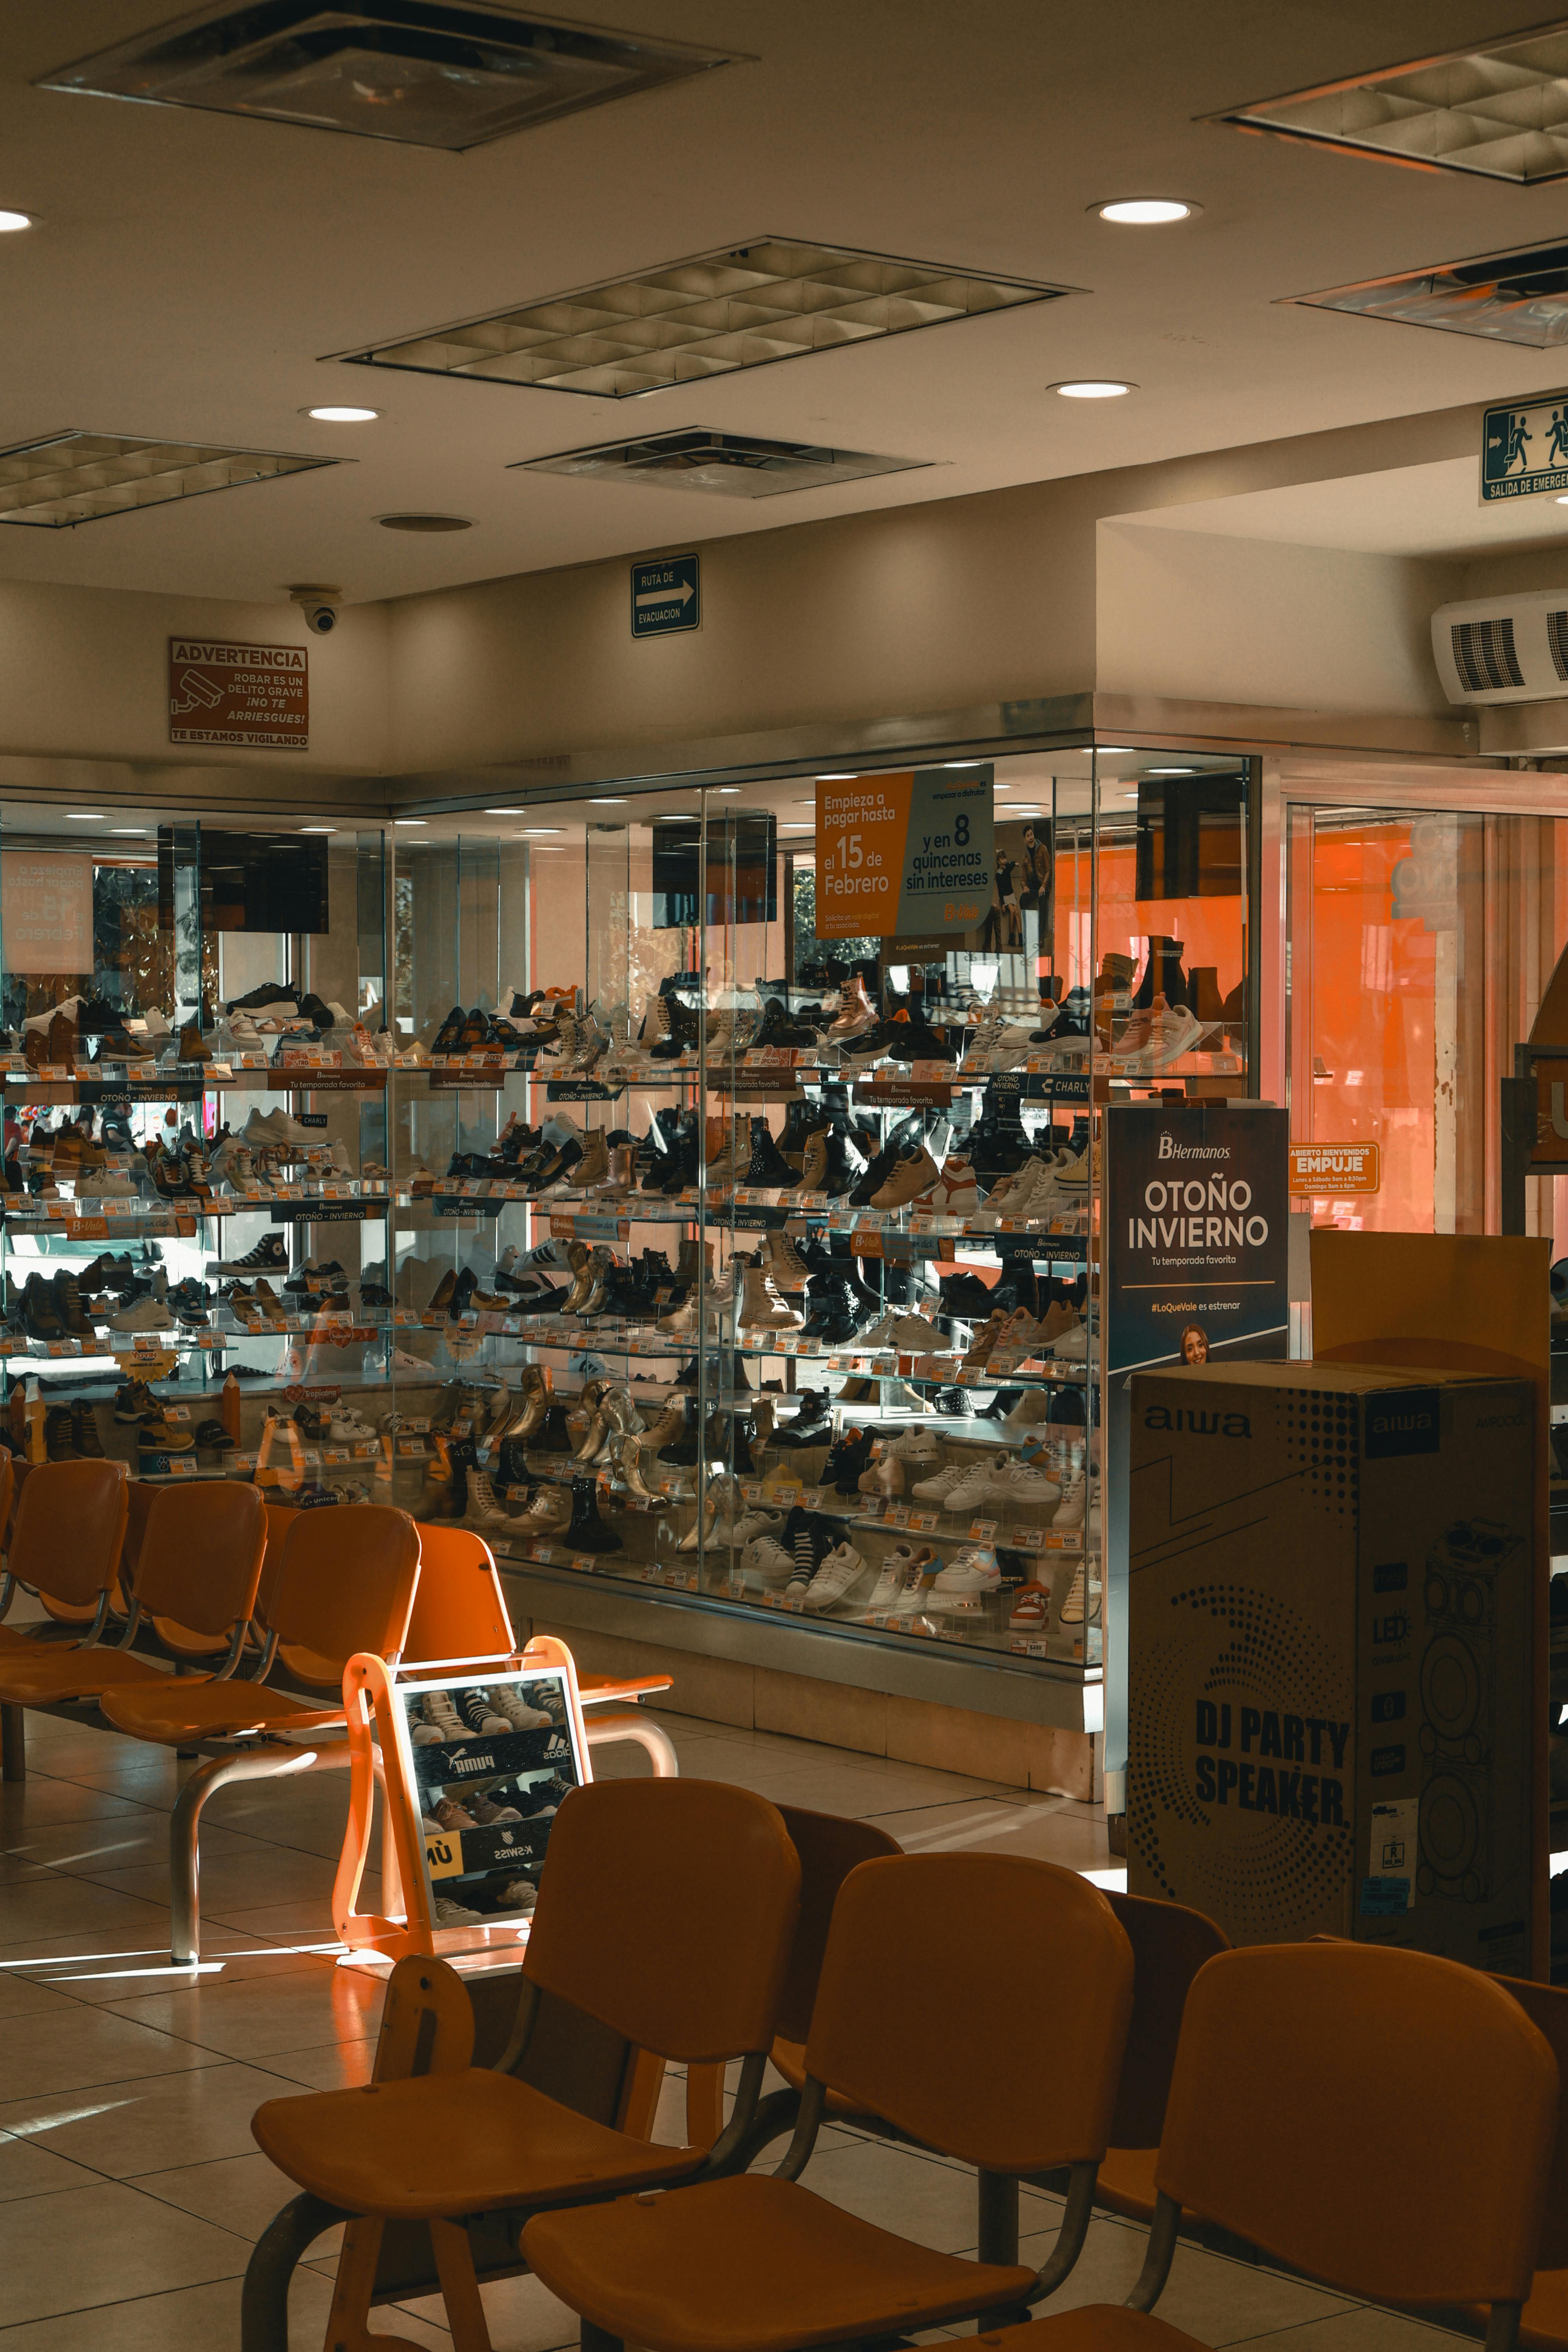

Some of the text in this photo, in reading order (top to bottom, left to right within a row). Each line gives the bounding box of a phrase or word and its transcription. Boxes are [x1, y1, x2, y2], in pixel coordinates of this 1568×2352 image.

[1490, 481, 1518, 497] SALIDA
[1521, 479, 1531, 493] DE
[642, 571, 673, 587] RUTA DE
[639, 608, 680, 624] EVACUACION
[175, 645, 303, 668] ADVERTENCIA
[234, 673, 303, 686] ROBAR ES UN
[228, 684, 303, 697] DELITO GRAVE
[246, 697, 286, 708] ¡NO TE
[227, 711, 305, 724] ARRIESGUES!
[172, 730, 307, 745] TE ESTAMOS VIGILANDO
[947, 781, 979, 790] #LoQueVale
[824, 792, 884, 812] Empieza a
[933, 792, 956, 800] empezar
[962, 789, 986, 797] disfrutar.
[824, 806, 895, 829] pagar hasta
[923, 814, 970, 853] y en 8
[824, 835, 882, 870] el 15 de
[913, 852, 981, 874] quincenas
[825, 873, 889, 896] Febrero
[907, 871, 988, 890] sin intereses
[825, 914, 844, 922] Solicita
[863, 912, 879, 921] digital
[299, 1081, 338, 1090] temporada
[1055, 1081, 1090, 1093] CHARLY
[101, 1093, 131, 1102] OTOÑO
[559, 1092, 577, 1100] OTOÑO
[877, 1096, 909, 1105] temporada
[909, 1096, 933, 1104] favorita
[1297, 1156, 1363, 1172] EMPUJE
[1145, 1172, 1252, 1212] OTOÑO
[296, 1213, 322, 1221] OTOÑO
[443, 1207, 459, 1215] OTOÑO
[738, 1218, 766, 1227] INVIERNO
[1129, 1215, 1269, 1249] INVIERNO
[1014, 1248, 1080, 1260] OTOÑO INVIERNO
[1152, 1255, 1236, 1267] Tu temporada favorita
[1152, 1303, 1197, 1312] #LoQueVale
[1208, 1301, 1241, 1310] estrenar
[1144, 1406, 1252, 1439] aiwa
[1373, 1412, 1433, 1434] aiwa
[1374, 1615, 1407, 1644] LED
[1196, 1699, 1350, 1769] DJ PARTY
[1196, 1755, 1343, 1827] SPEAKER
[1390, 1847, 1397, 1858] R
